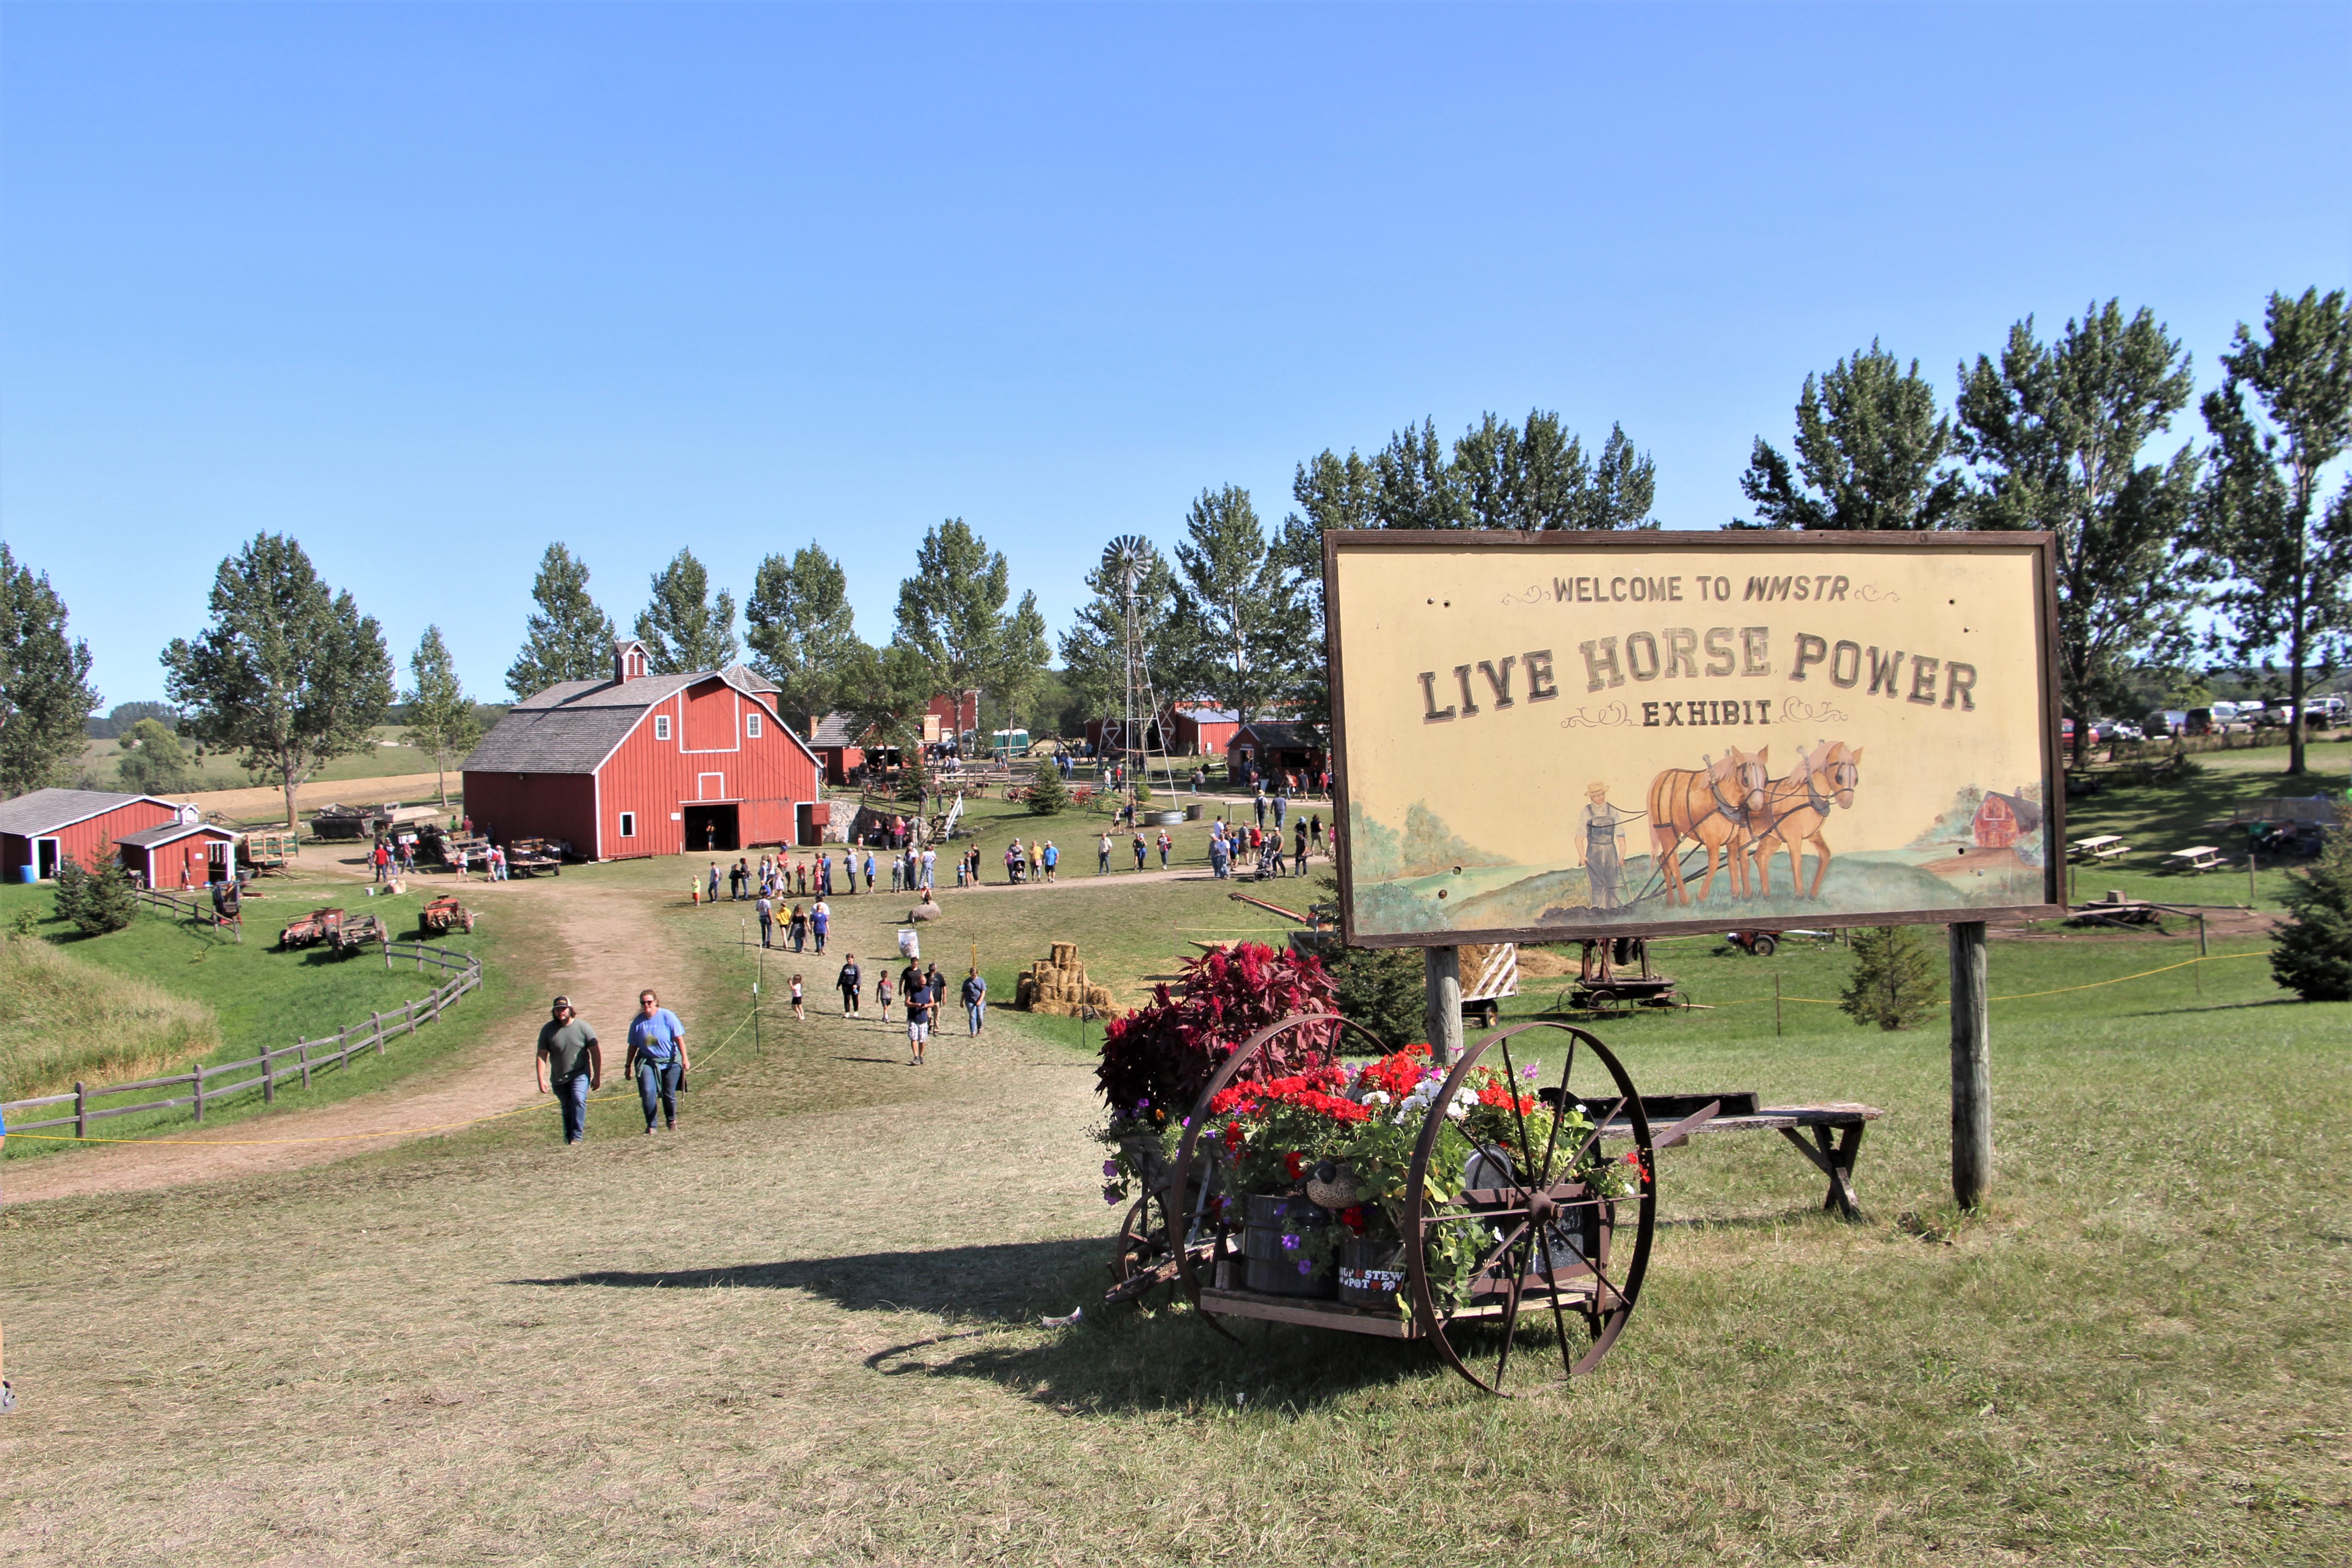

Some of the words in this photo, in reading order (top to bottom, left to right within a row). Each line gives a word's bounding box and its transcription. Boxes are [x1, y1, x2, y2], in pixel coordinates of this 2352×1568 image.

[1553, 576, 1683, 603] WELCOME
[1695, 576, 1731, 602] TO
[1742, 575, 1850, 602] WMSTR
[1417, 649, 1559, 725] LIVE
[1579, 626, 1771, 693] HORSE
[1789, 632, 1978, 712] POWER
[1641, 699, 1772, 727] EXHIBIT
[1348, 1278, 1369, 1289] POT
[1365, 1270, 1404, 1281] STEW
